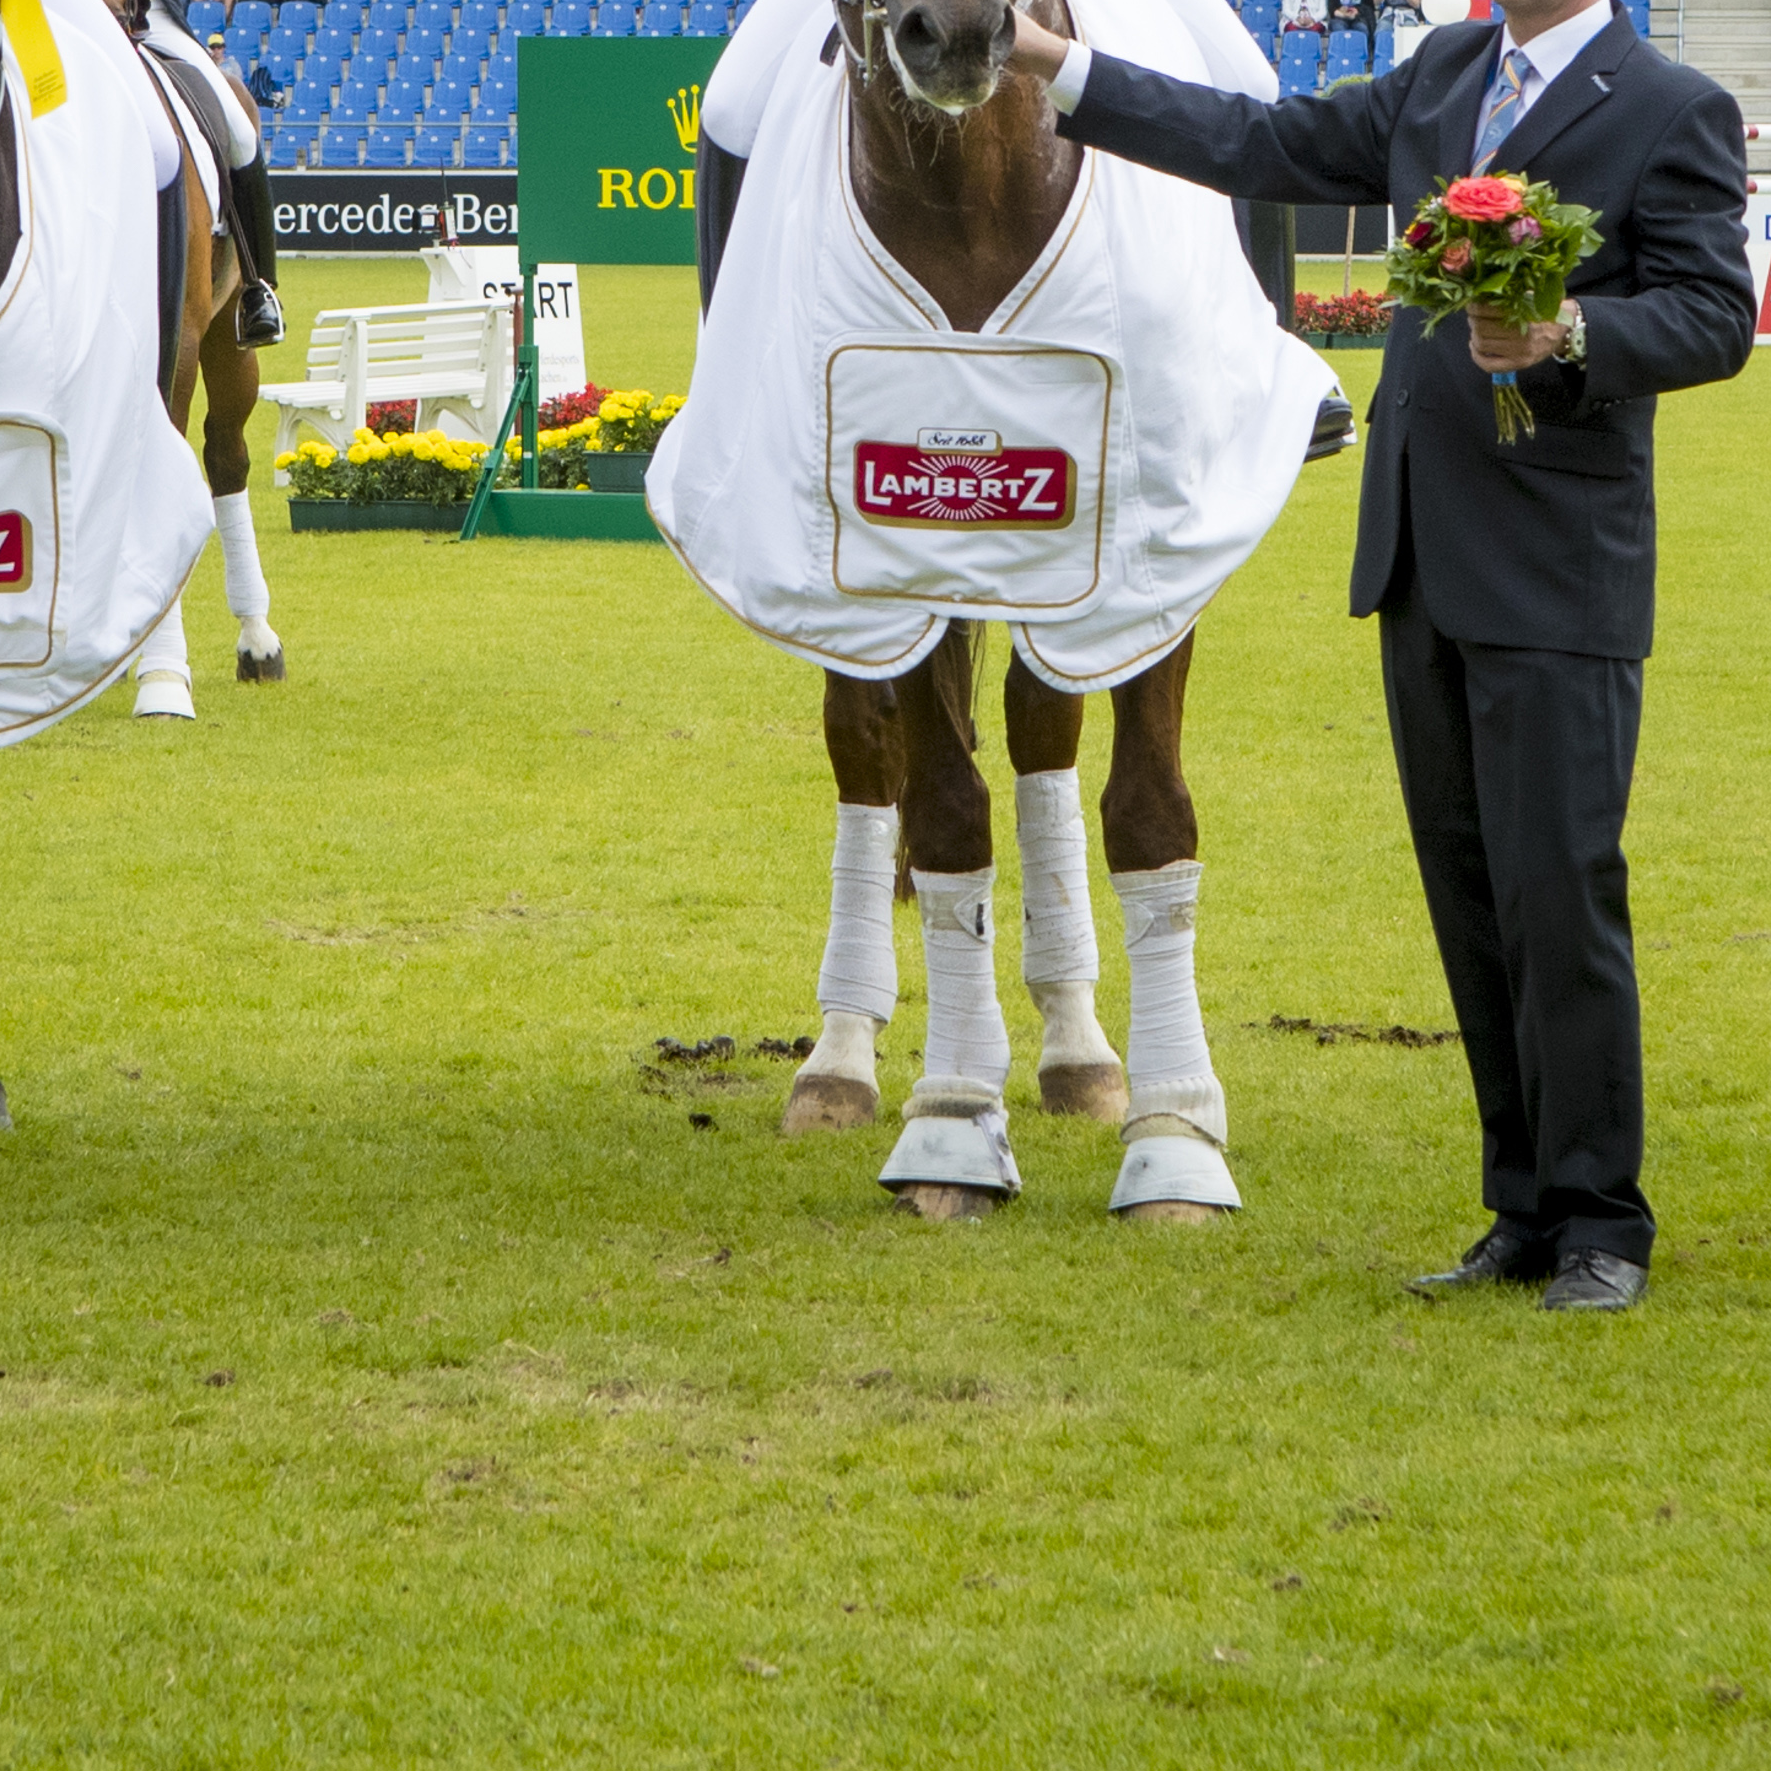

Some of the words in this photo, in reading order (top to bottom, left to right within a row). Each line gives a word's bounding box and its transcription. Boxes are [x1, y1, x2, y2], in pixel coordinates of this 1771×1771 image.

[928, 431, 951, 446] Seit
[955, 434, 987, 446] 1688
[864, 460, 1058, 512] LAMBERTZ
